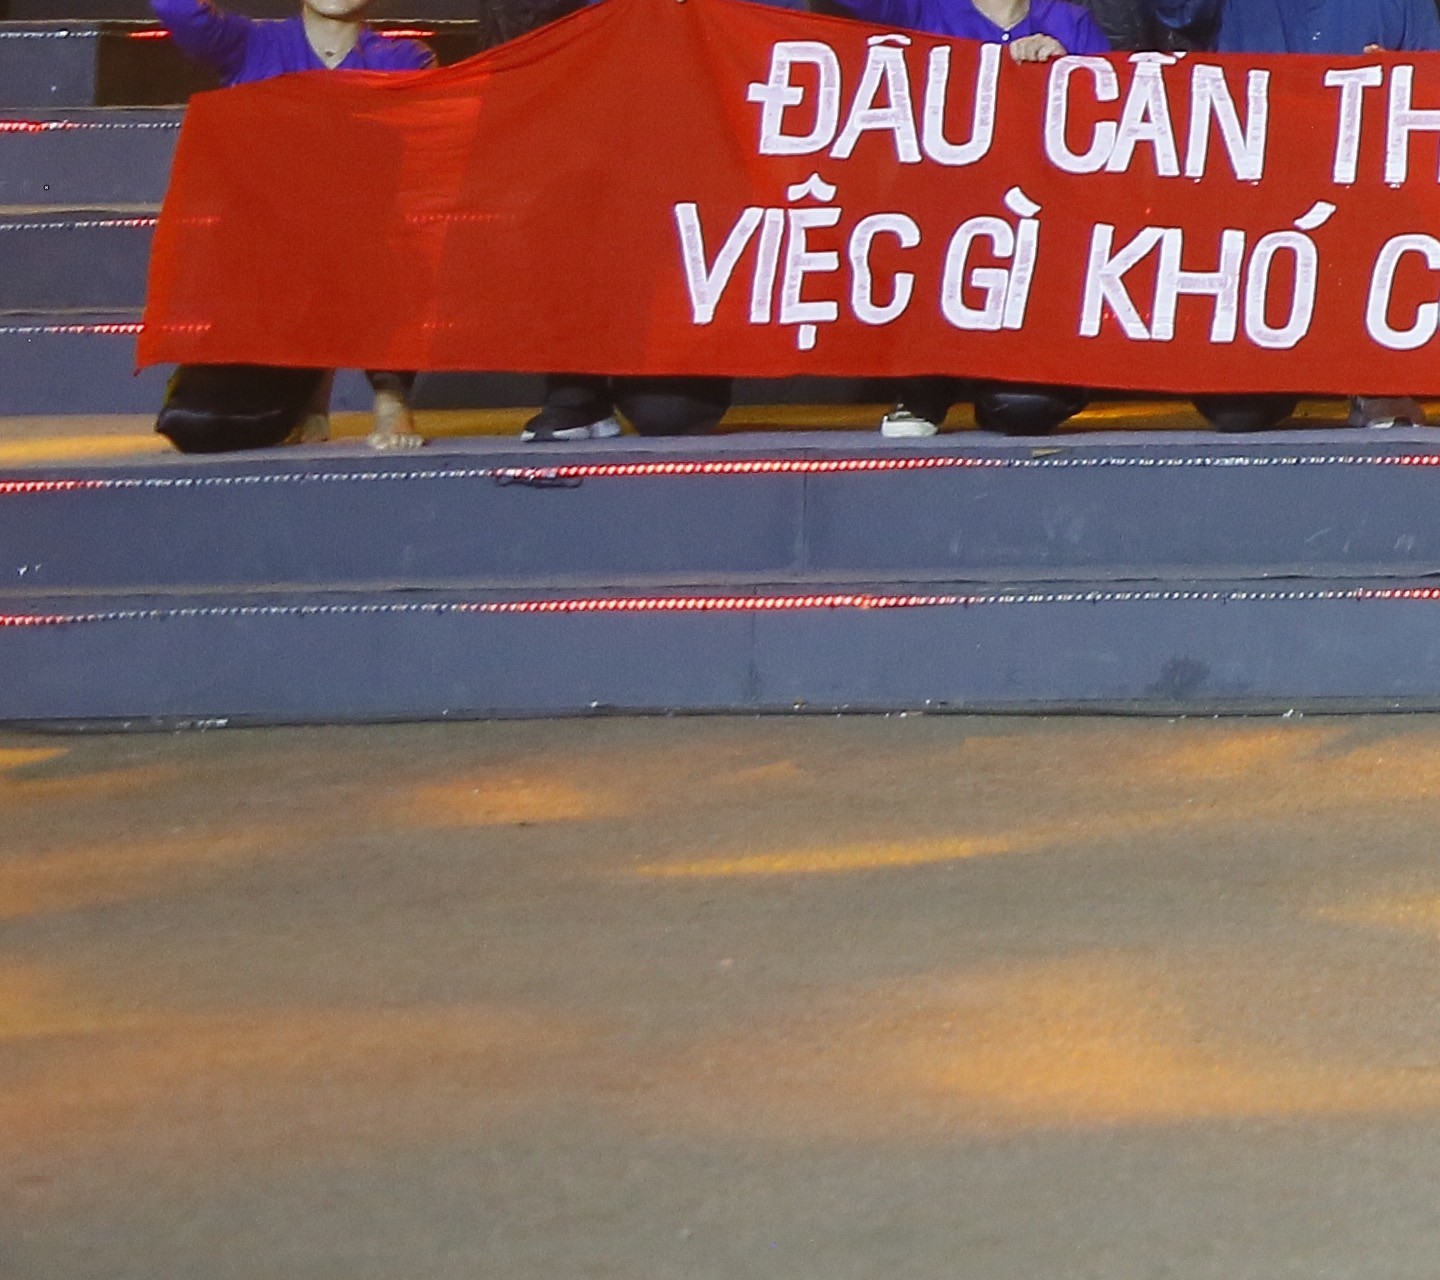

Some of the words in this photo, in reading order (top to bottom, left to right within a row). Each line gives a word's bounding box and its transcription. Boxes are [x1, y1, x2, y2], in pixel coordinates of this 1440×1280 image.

[747, 33, 1002, 166] ĐÂU
[674, 172, 921, 351] VIỆC
[940, 186, 1042, 333] GÌ
[1079, 201, 1337, 351] KHÓ
